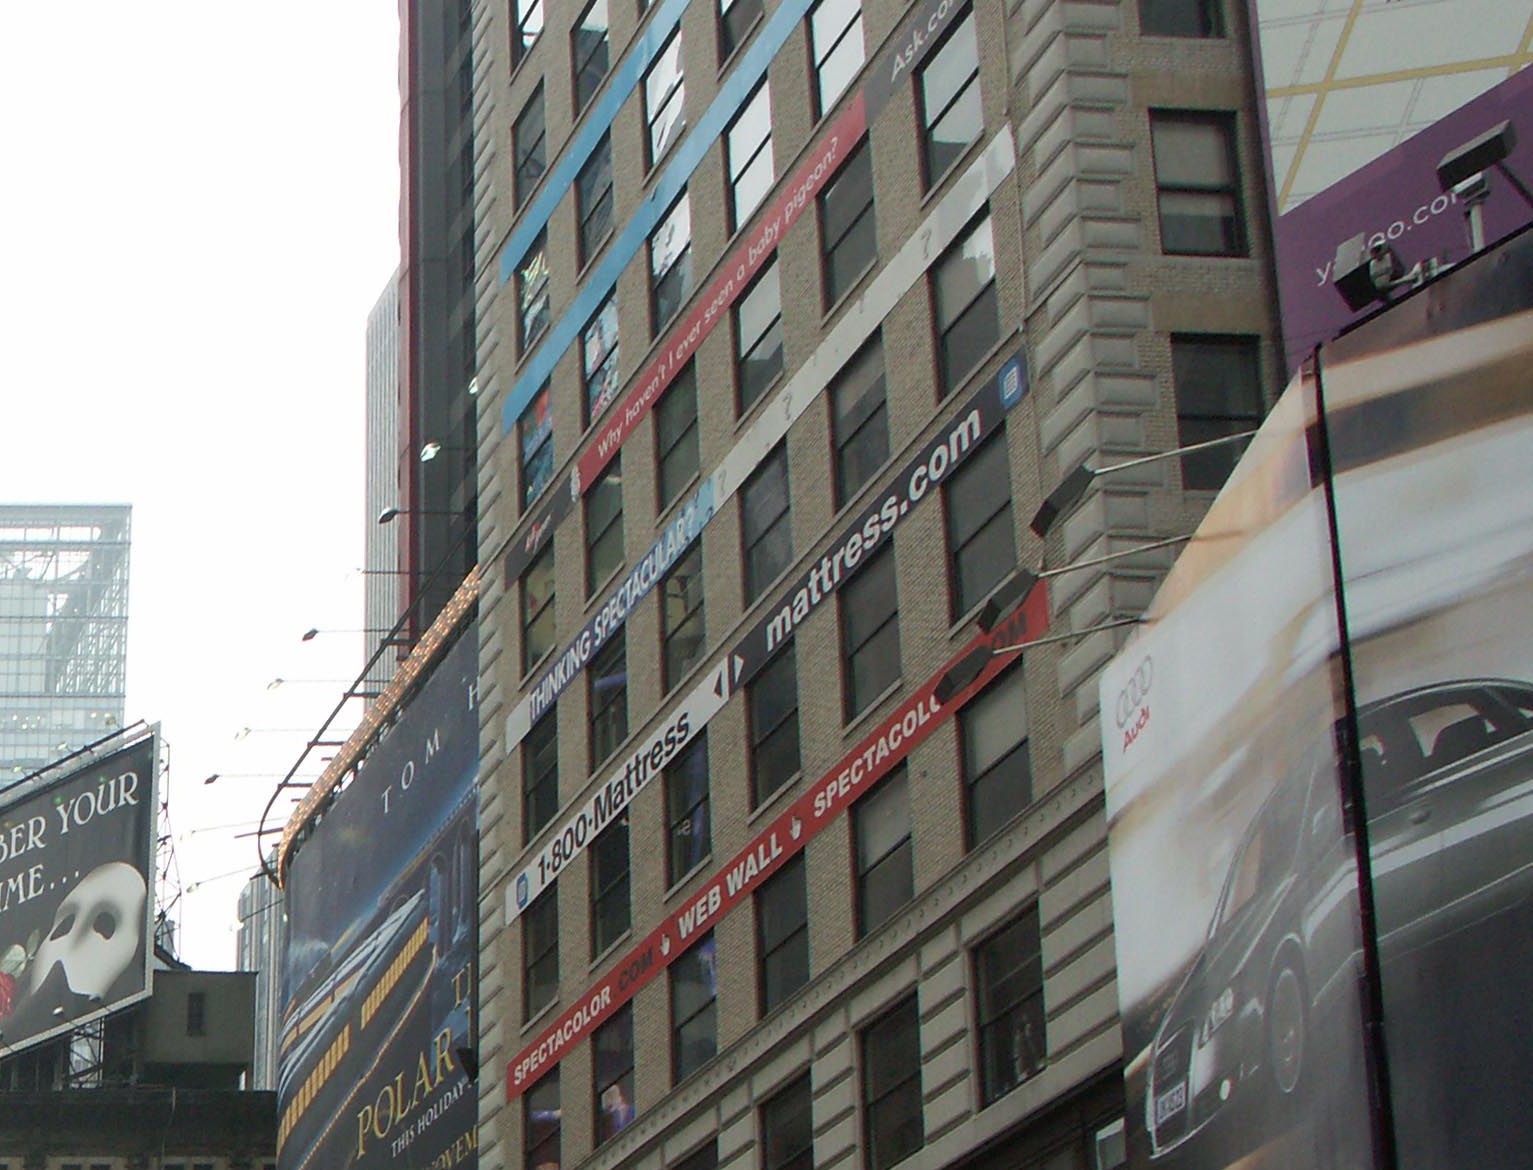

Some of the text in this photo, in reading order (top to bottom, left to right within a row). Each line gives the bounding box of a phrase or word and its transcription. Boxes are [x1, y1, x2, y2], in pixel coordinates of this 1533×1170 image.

[596, 423, 624, 460] Why
[625, 364, 666, 420] haven't
[675, 319, 703, 361] ever
[703, 280, 735, 325] seen
[736, 267, 746, 281] a
[747, 219, 782, 271] baby
[783, 136, 840, 226] pigeon?
[528, 503, 698, 722] THINKING SPECTACULAR?
[1122, 704, 1151, 754] Audi
[55, 769, 139, 837] YOUR
[355, 1026, 456, 1161] POLAR
[390, 1084, 465, 1161] THIS HOLIDAY
